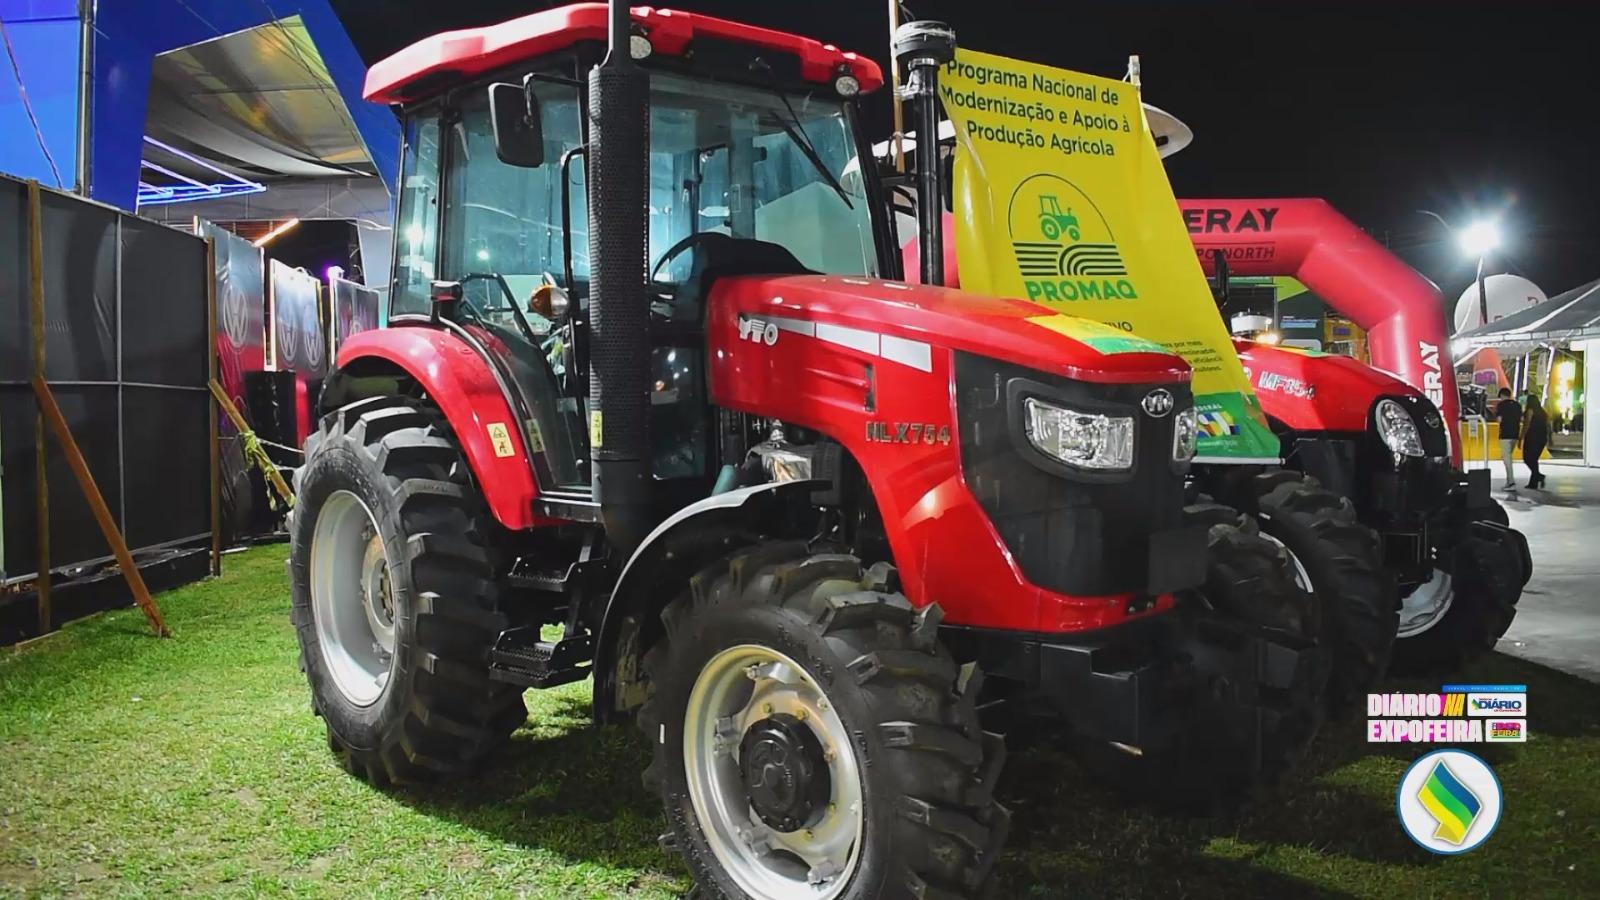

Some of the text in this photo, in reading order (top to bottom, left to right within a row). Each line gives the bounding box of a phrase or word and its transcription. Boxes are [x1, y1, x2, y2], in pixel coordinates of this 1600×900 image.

[947, 59, 1119, 106] Programa Nacional de
[941, 84, 1130, 132] Modernização e Apoio à
[967, 120, 1114, 156] Produção Agrícola
[1024, 280, 1138, 301] PROMAQ
[739, 316, 779, 346] YTO
[865, 420, 951, 447] NLX754
